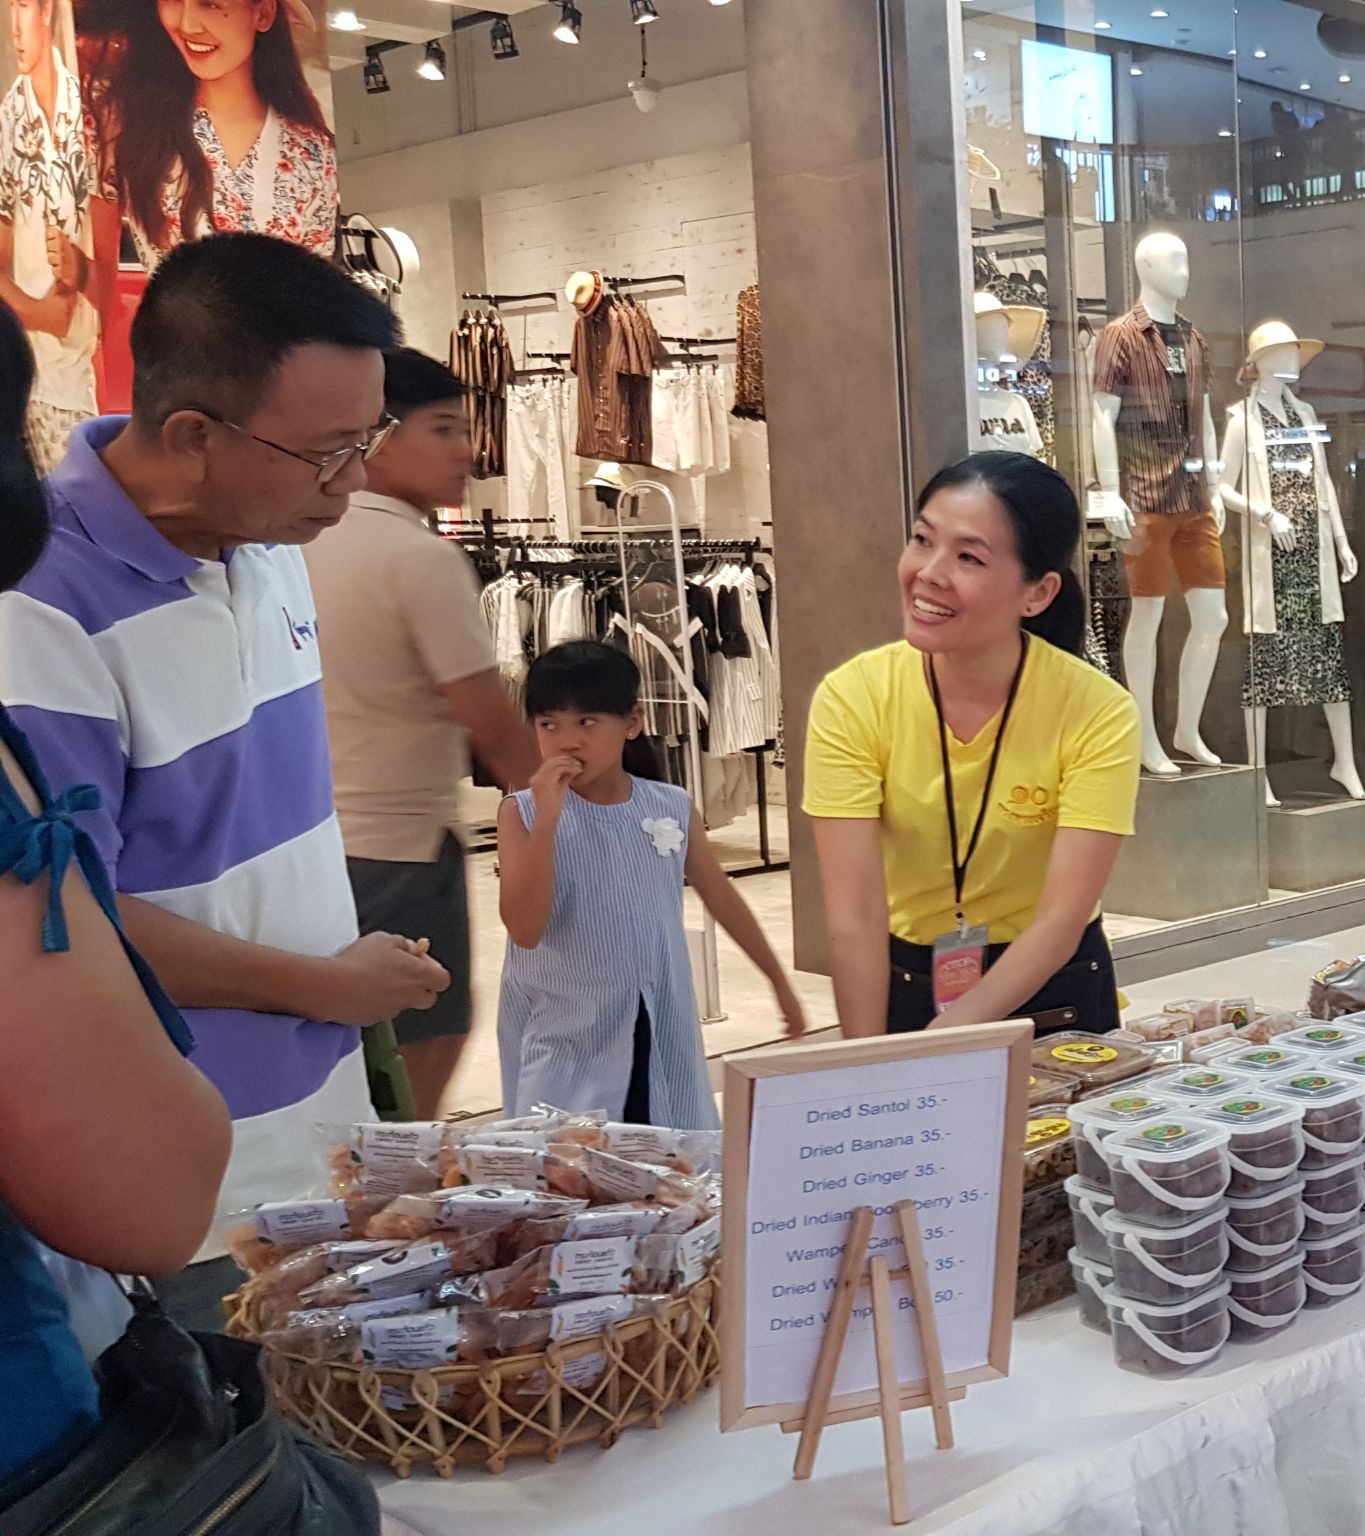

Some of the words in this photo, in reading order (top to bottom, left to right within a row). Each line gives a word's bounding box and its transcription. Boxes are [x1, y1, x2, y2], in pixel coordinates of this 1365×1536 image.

[806, 1106, 852, 1124] Dried
[858, 1098, 910, 1117] Santol
[916, 1094, 948, 1110] 35.-
[799, 1143, 845, 1160] Dried
[851, 1134, 914, 1152] Banana
[920, 1128, 952, 1143] 35.-
[802, 1177, 847, 1193] Dried
[854, 1168, 909, 1186] Ginger
[914, 1163, 945, 1177] 35.-
[751, 1216, 796, 1235] Dried
[803, 1210, 853, 1227] Indian
[867, 1234, 905, 1250] Can
[772, 1279, 816, 1298] Dried
[770, 1312, 814, 1331] Dried
